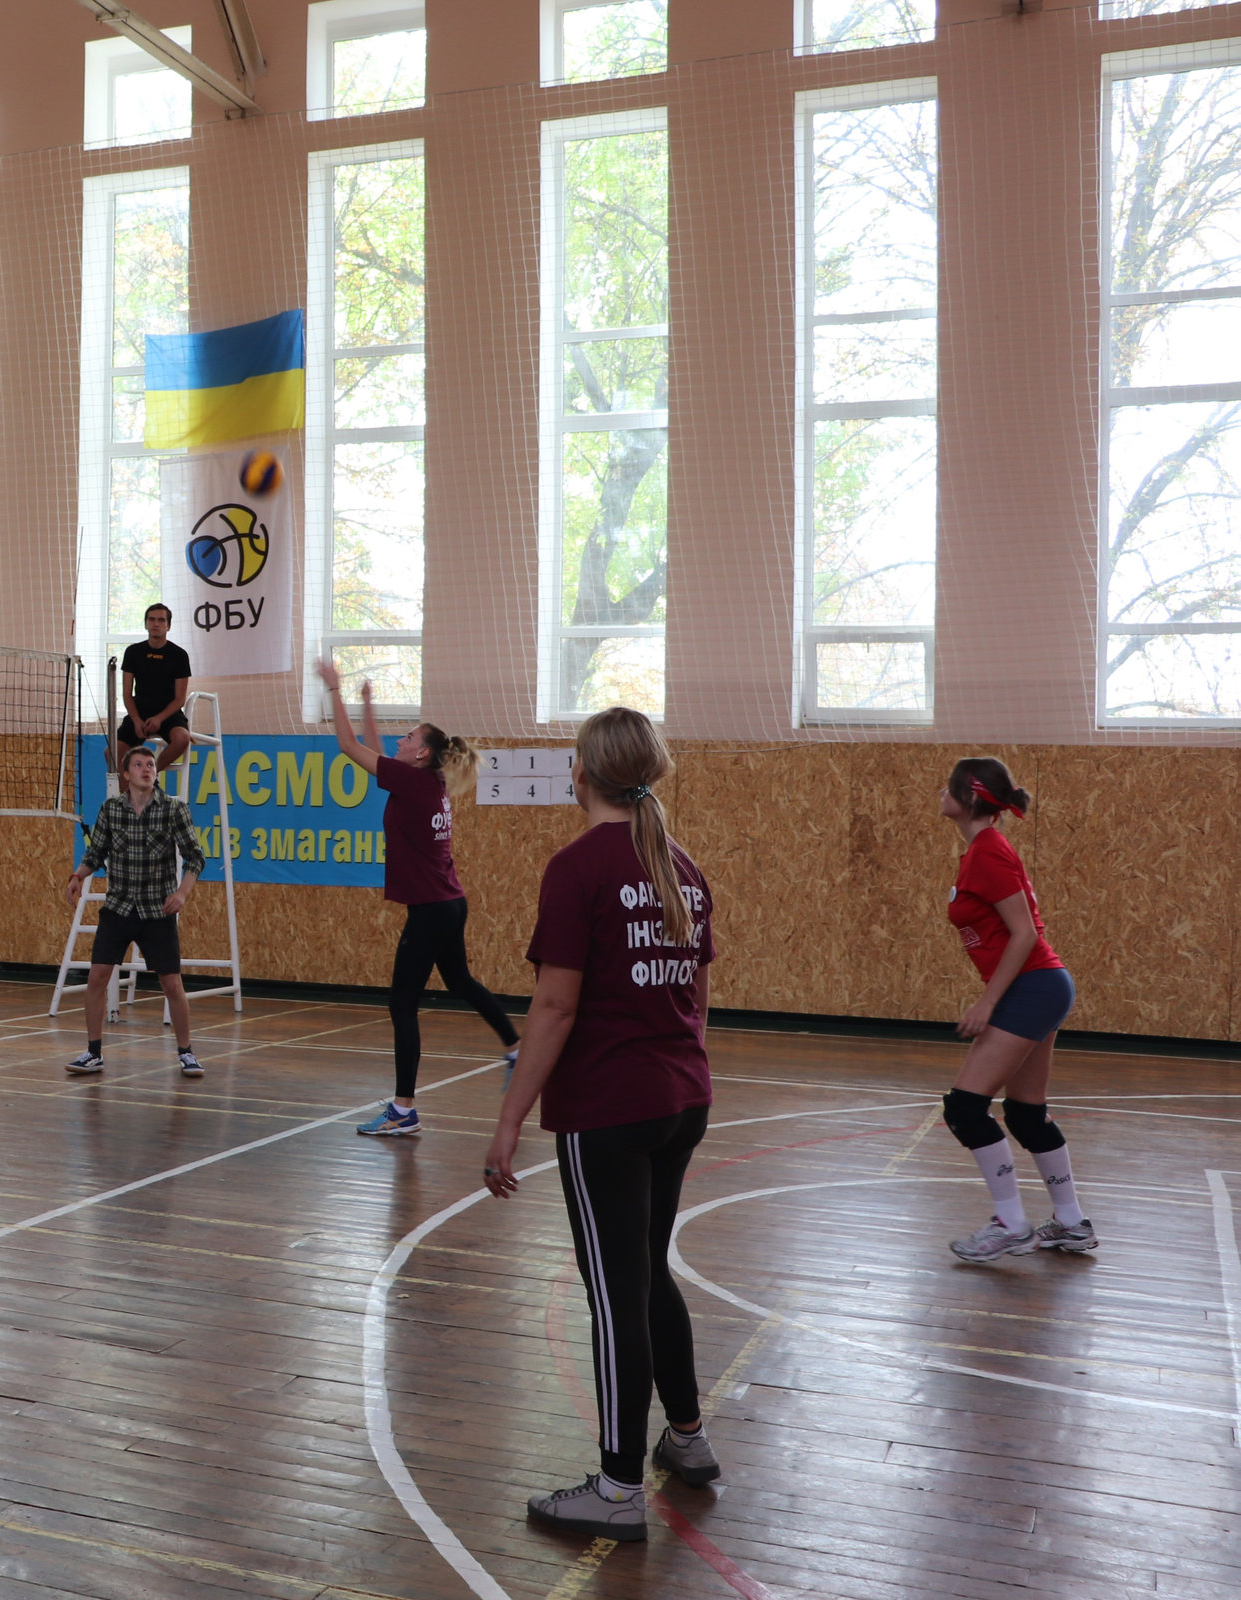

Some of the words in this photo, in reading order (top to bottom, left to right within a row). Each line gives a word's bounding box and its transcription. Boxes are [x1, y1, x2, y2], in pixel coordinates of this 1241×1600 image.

[194, 597, 264, 632] ФБУ
[489, 757, 498, 769] 2
[529, 756, 535, 769] 1
[491, 785, 500, 797] 5
[527, 785, 535, 797] 4
[565, 784, 574, 796] 4
